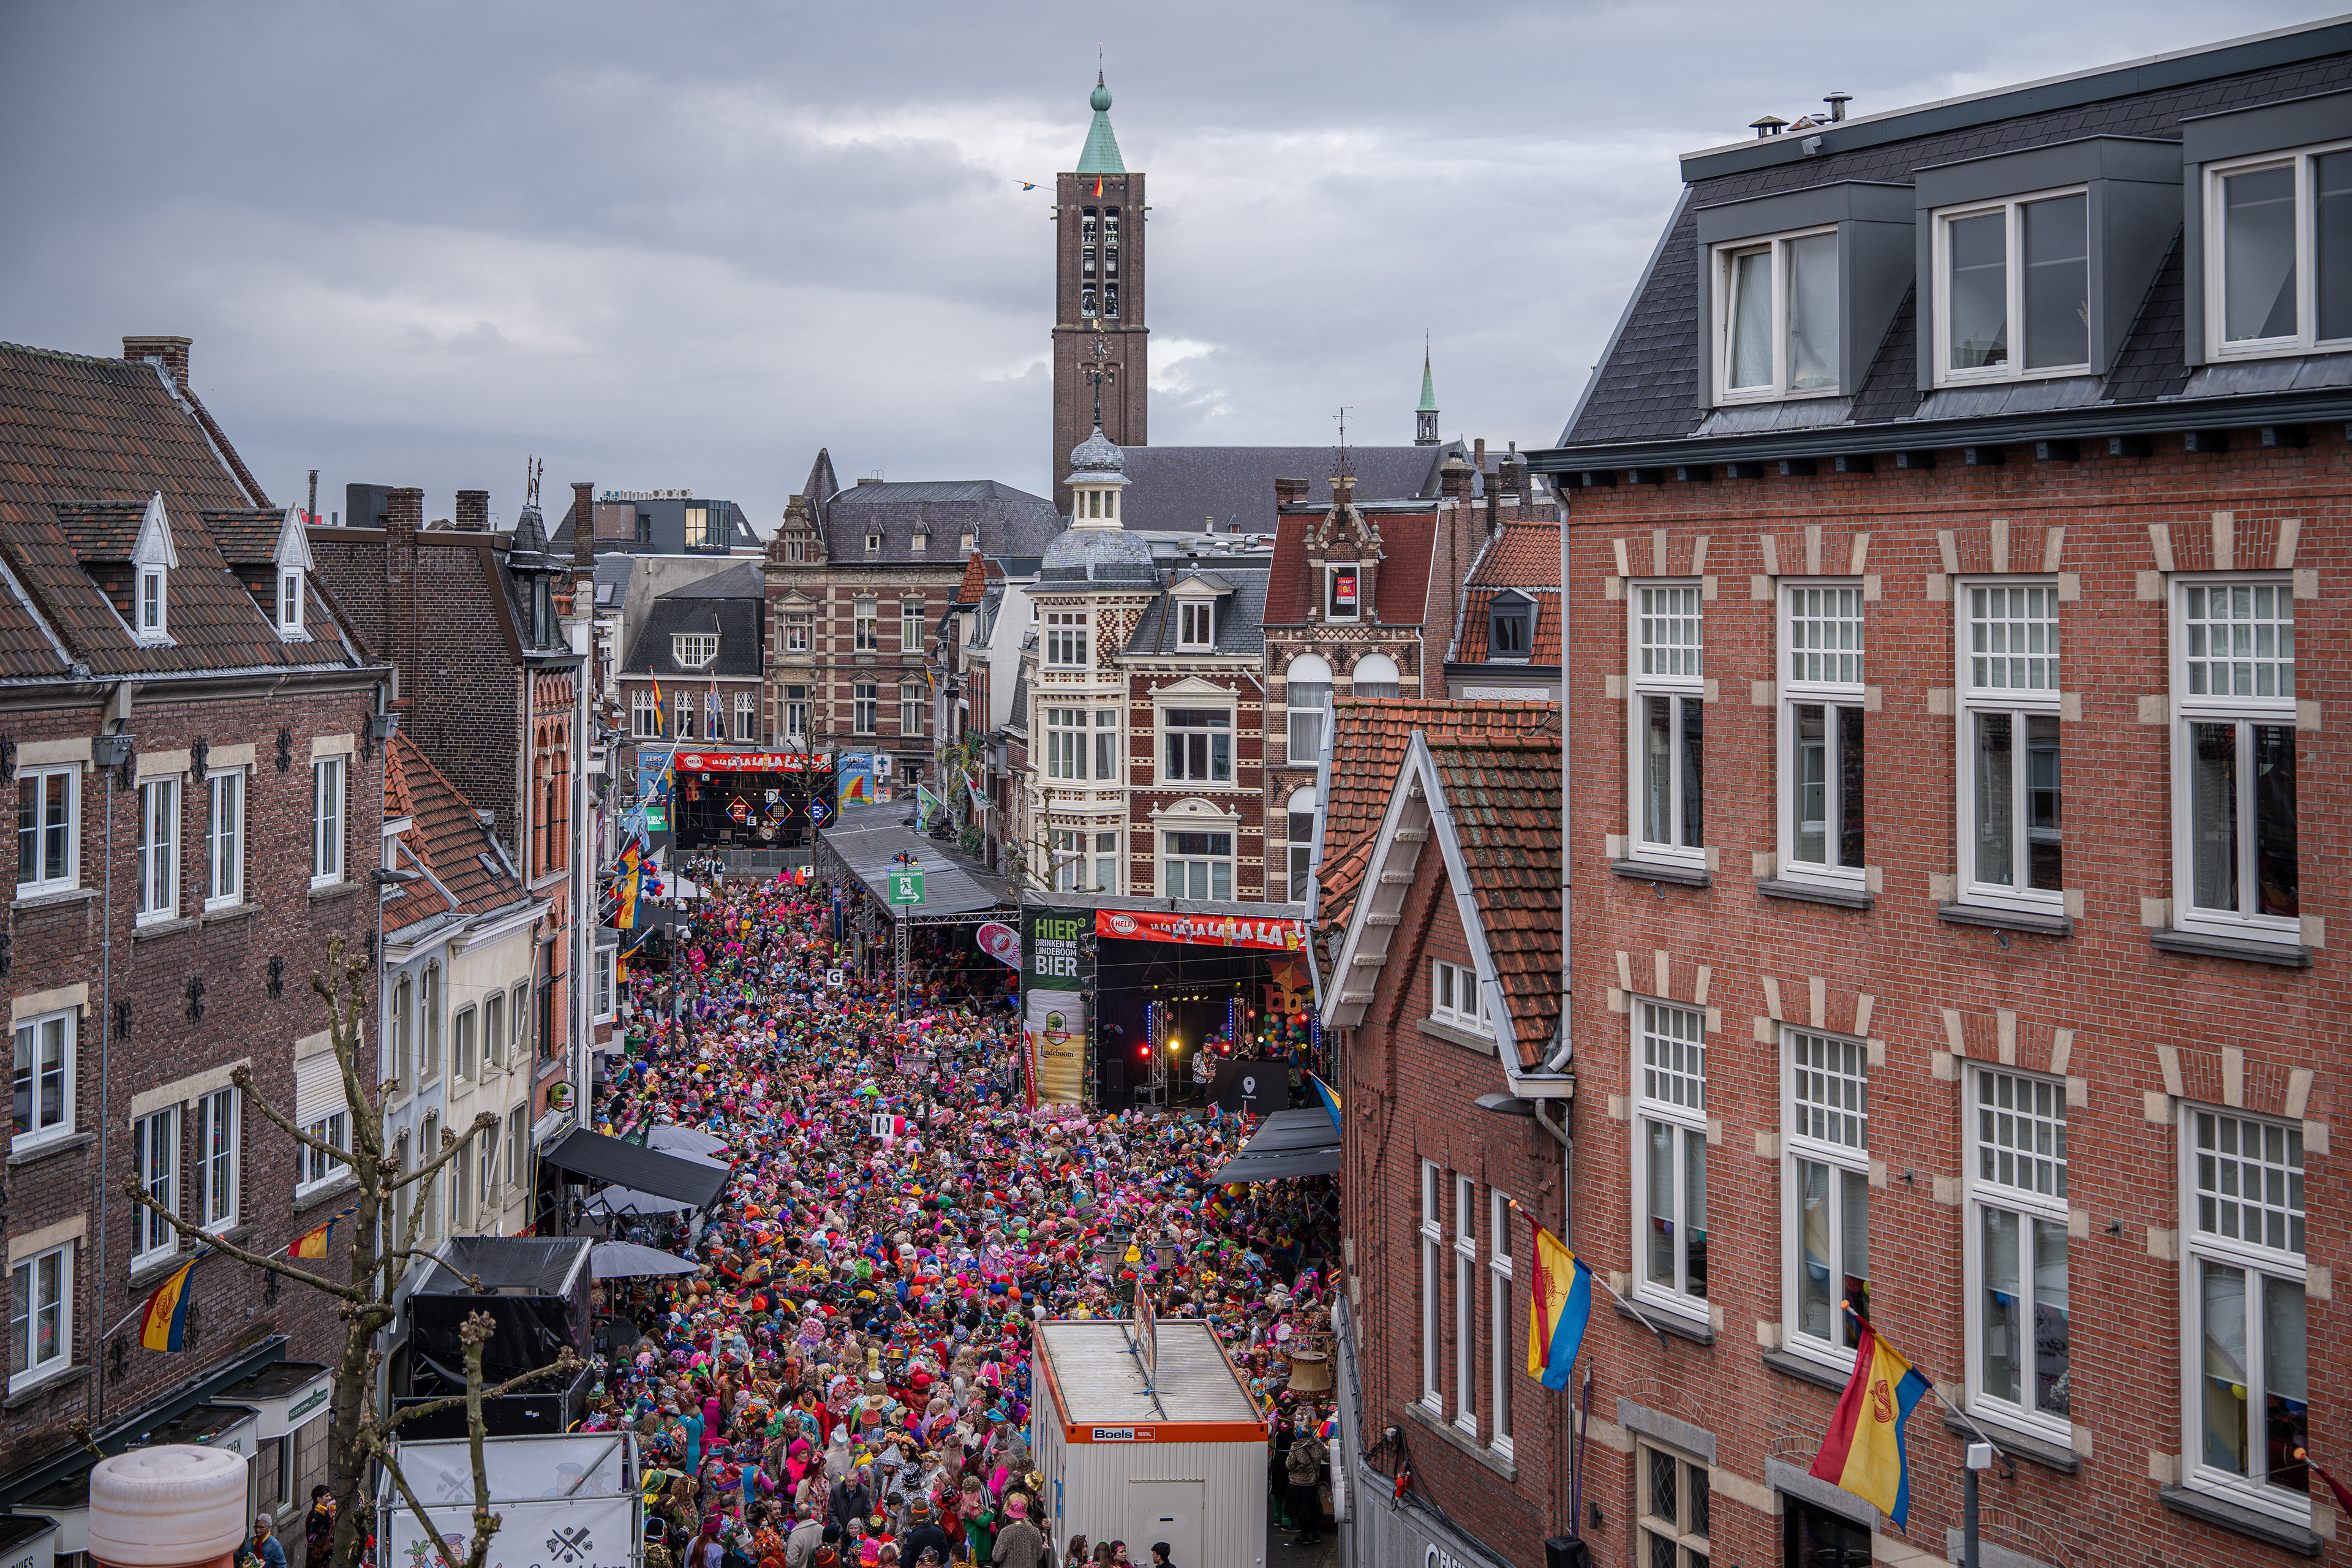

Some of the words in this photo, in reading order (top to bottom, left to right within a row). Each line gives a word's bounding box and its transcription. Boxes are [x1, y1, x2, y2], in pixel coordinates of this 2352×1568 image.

[740, 758, 751, 766] LA
[752, 757, 763, 767] LA
[767, 756, 783, 767] LA
[768, 791, 777, 802] D
[805, 867, 810, 875] F
[1035, 919, 1078, 940] HIER
[1160, 922, 1171, 932] LA
[1172, 923, 1187, 935] LA
[1190, 923, 1206, 936] LA
[1208, 922, 1224, 938] LA
[1231, 922, 1254, 940] LA
[1256, 922, 1284, 946] LA
[1035, 938, 1065, 948] DRINKEN
[1066, 940, 1077, 949] WE
[1035, 947, 1077, 957] LINDEBOOM
[1035, 955, 1077, 977] BIER
[829, 971, 840, 983] G
[1039, 1045, 1074, 1058] Lindeboom
[1095, 1430, 1133, 1439] Boels
